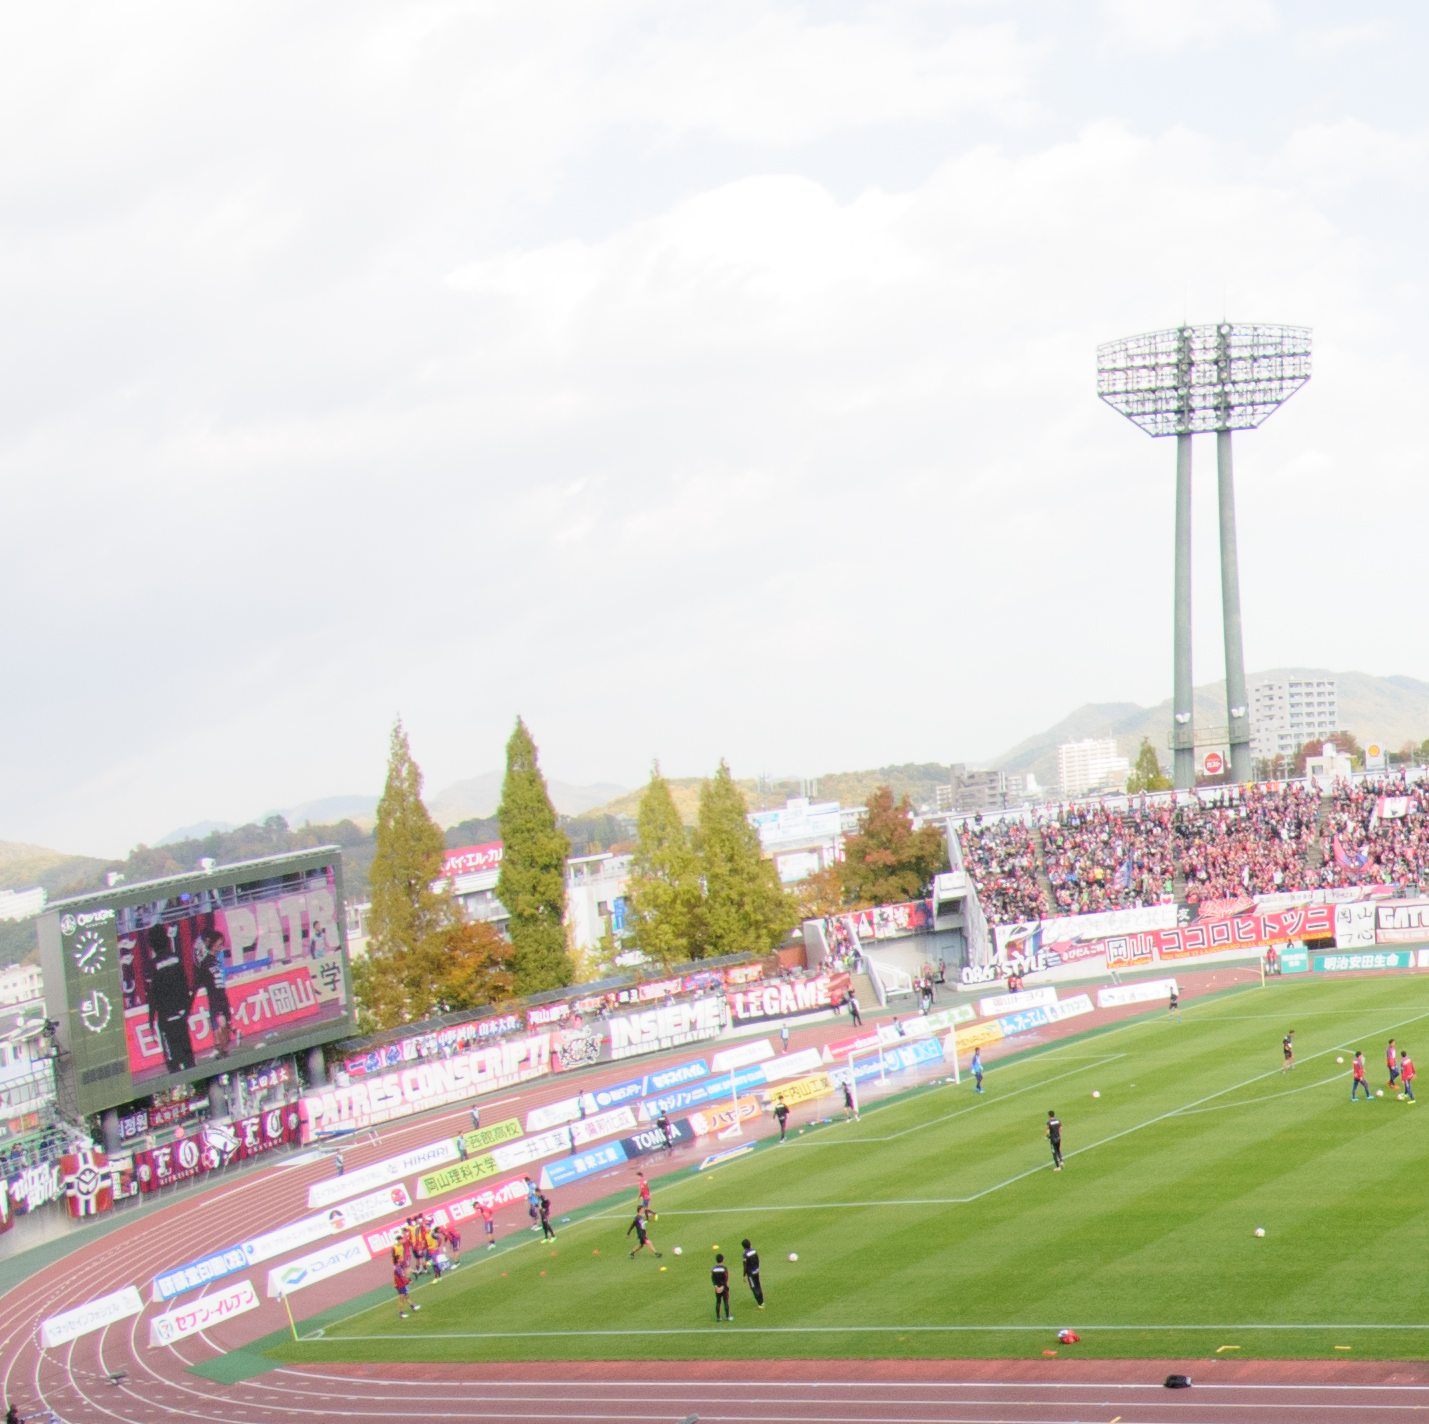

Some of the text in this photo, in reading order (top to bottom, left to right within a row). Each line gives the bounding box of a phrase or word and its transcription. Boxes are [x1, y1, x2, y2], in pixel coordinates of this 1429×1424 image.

[1160, 907, 1331, 953] ココロヒトツニ
[1107, 934, 1152, 963] 岡山
[1323, 953, 1399, 971] 明治安田生命
[961, 965, 995, 984] 086
[1001, 951, 1047, 980] STYLE
[735, 978, 832, 1019] LEGAME
[609, 996, 721, 1047] INSIEME
[1014, 1008, 1047, 1027] オーエム
[955, 1030, 993, 1048] PENALTY
[306, 1073, 402, 1130] PATRES
[401, 1035, 551, 1102] CONSCRIPTI
[403, 1146, 449, 1169] HIKARI
[513, 1131, 569, 1160] 一井工業
[423, 1156, 498, 1193] 岡山理科大学
[310, 1246, 361, 1274] DAIYA
[174, 1290, 254, 1332] セブン-イレブン
